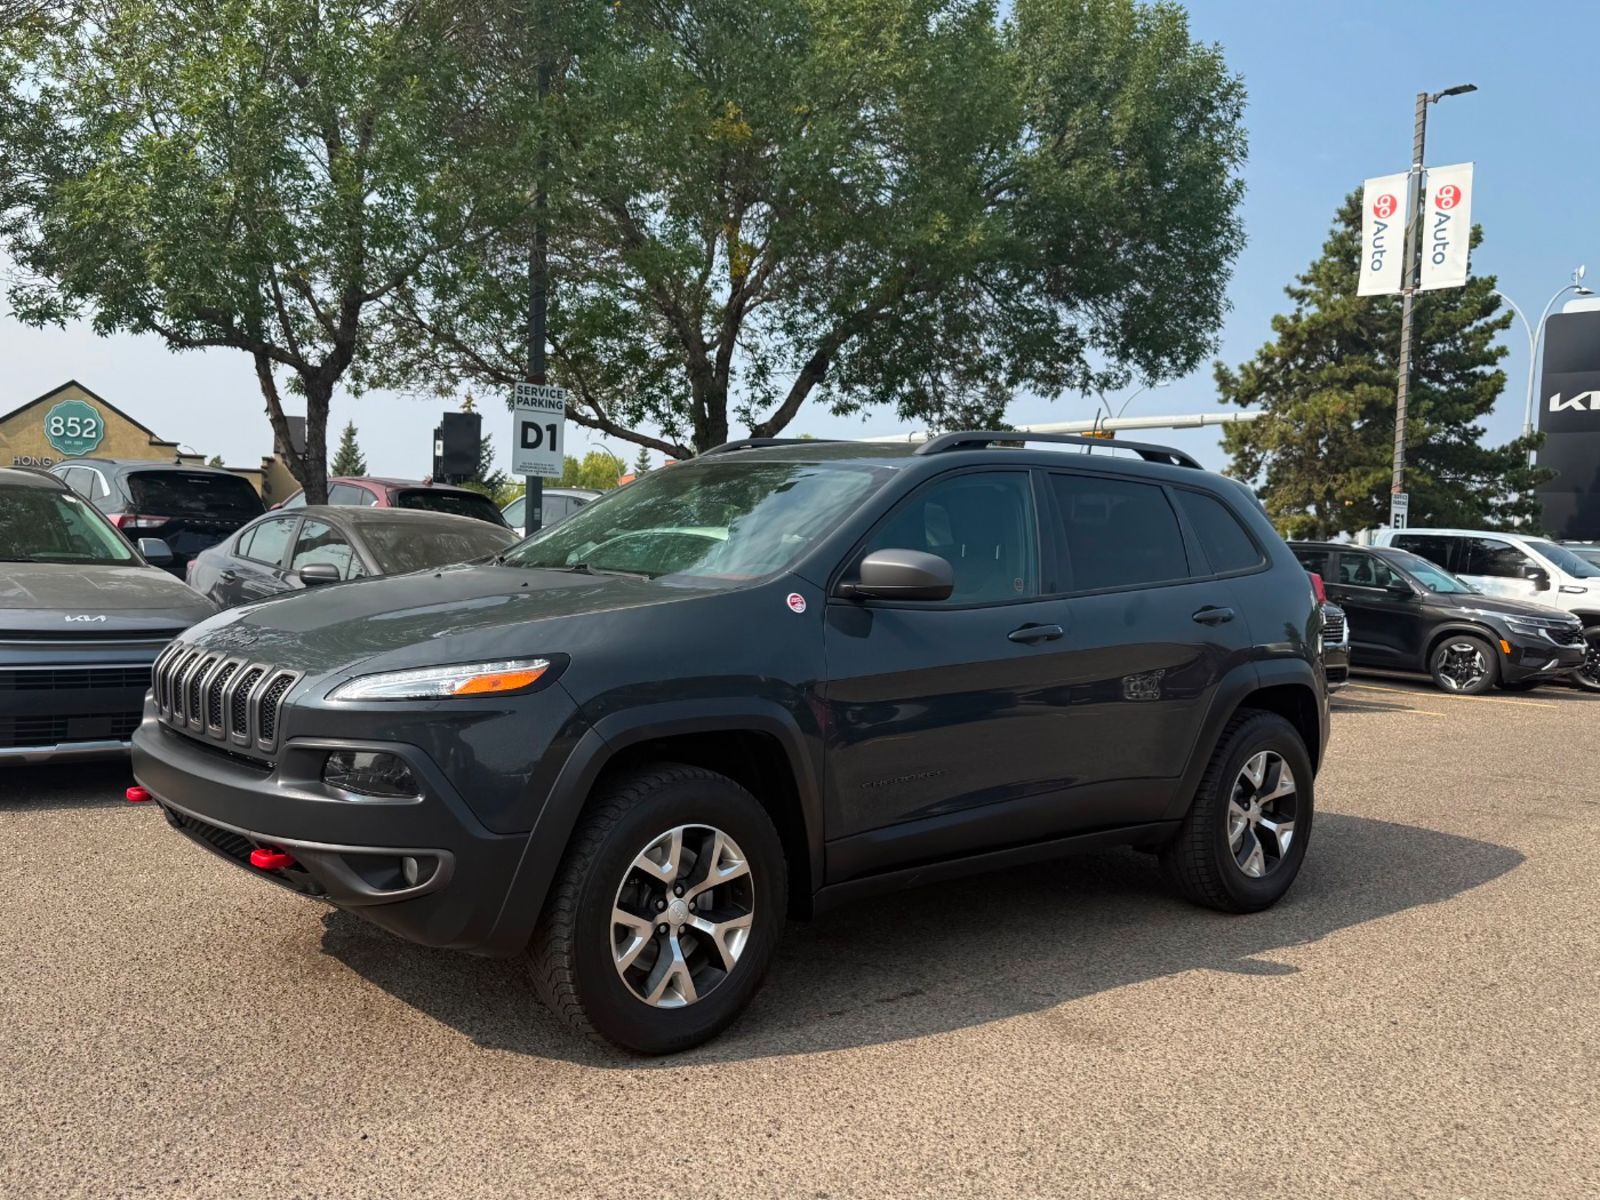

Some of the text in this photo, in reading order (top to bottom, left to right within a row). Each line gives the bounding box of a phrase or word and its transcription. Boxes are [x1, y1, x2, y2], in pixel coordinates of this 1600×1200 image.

[1371, 220, 1388, 272] Auto
[1432, 211, 1451, 265] Auto
[516, 385, 564, 400] SERVICE
[1549, 390, 1600, 412] KI
[516, 396, 563, 410] PARKING
[50, 416, 97, 438] 852
[520, 420, 557, 452] D1
[12, 455, 52, 467] HONG
[1393, 513, 1405, 529] E1
[64, 614, 106, 622] KIA
